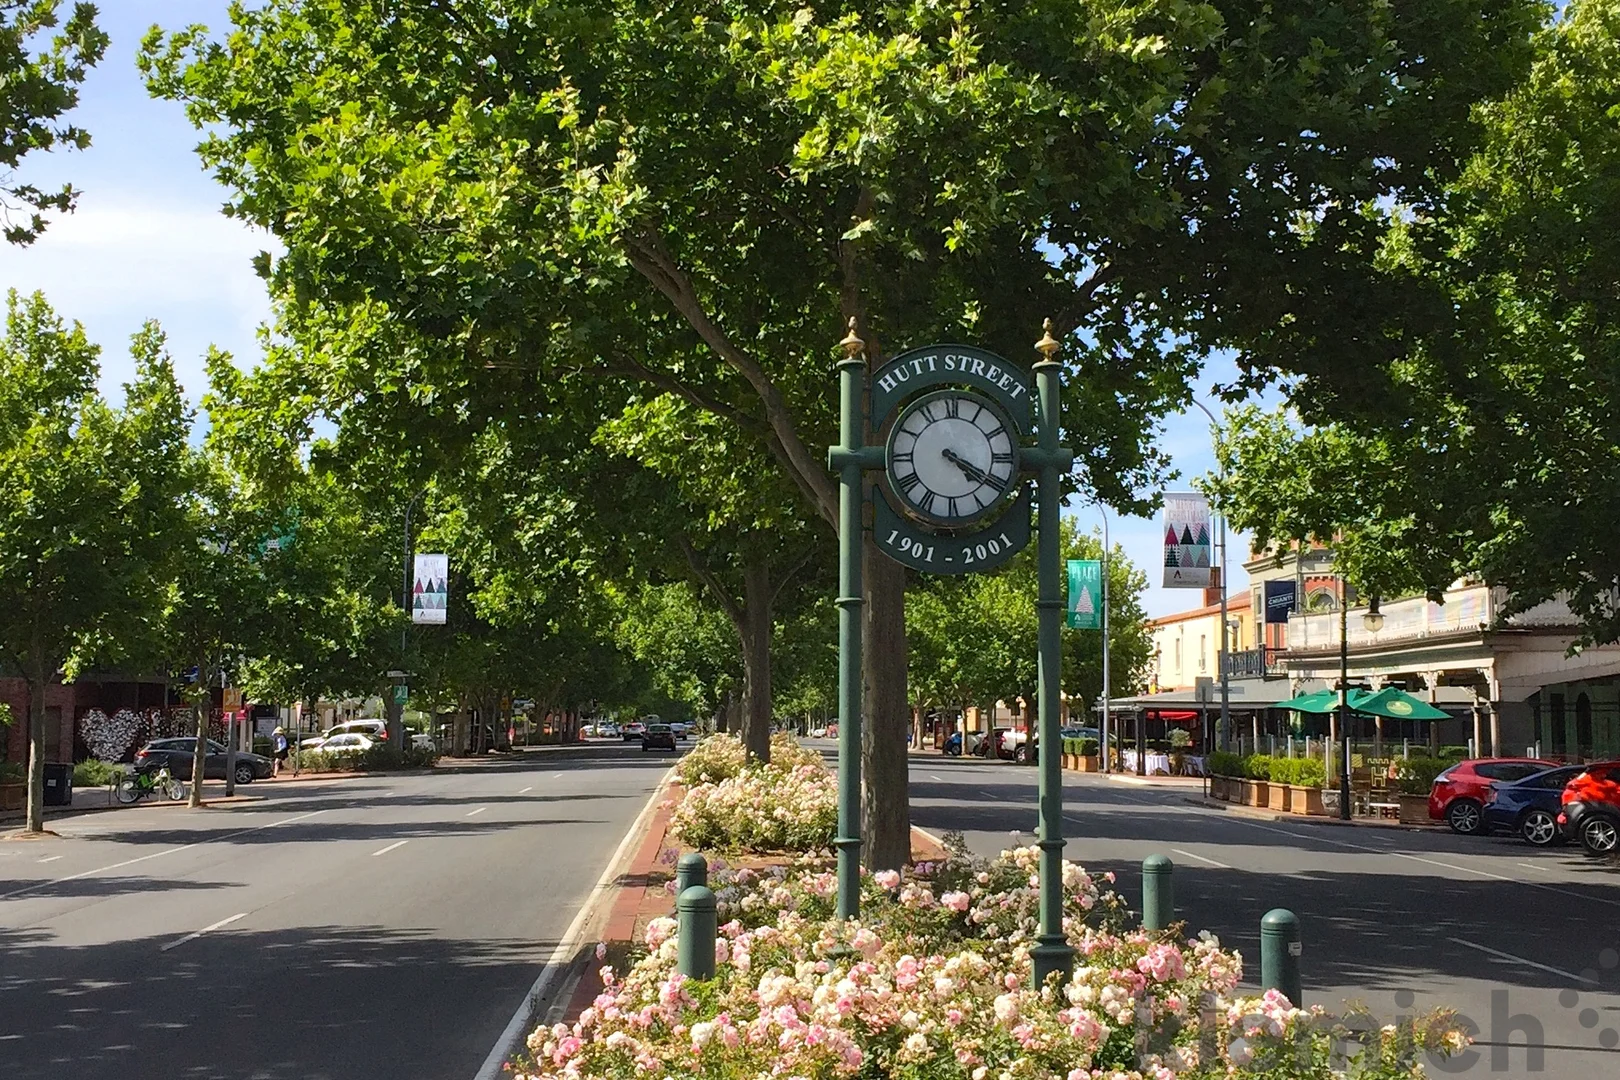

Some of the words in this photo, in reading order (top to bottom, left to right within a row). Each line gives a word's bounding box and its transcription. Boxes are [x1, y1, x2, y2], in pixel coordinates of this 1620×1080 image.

[877, 355, 938, 393] HUTT
[944, 354, 1026, 400] STREET
[885, 530, 934, 562] 1901
[962, 532, 1013, 564] 2001
